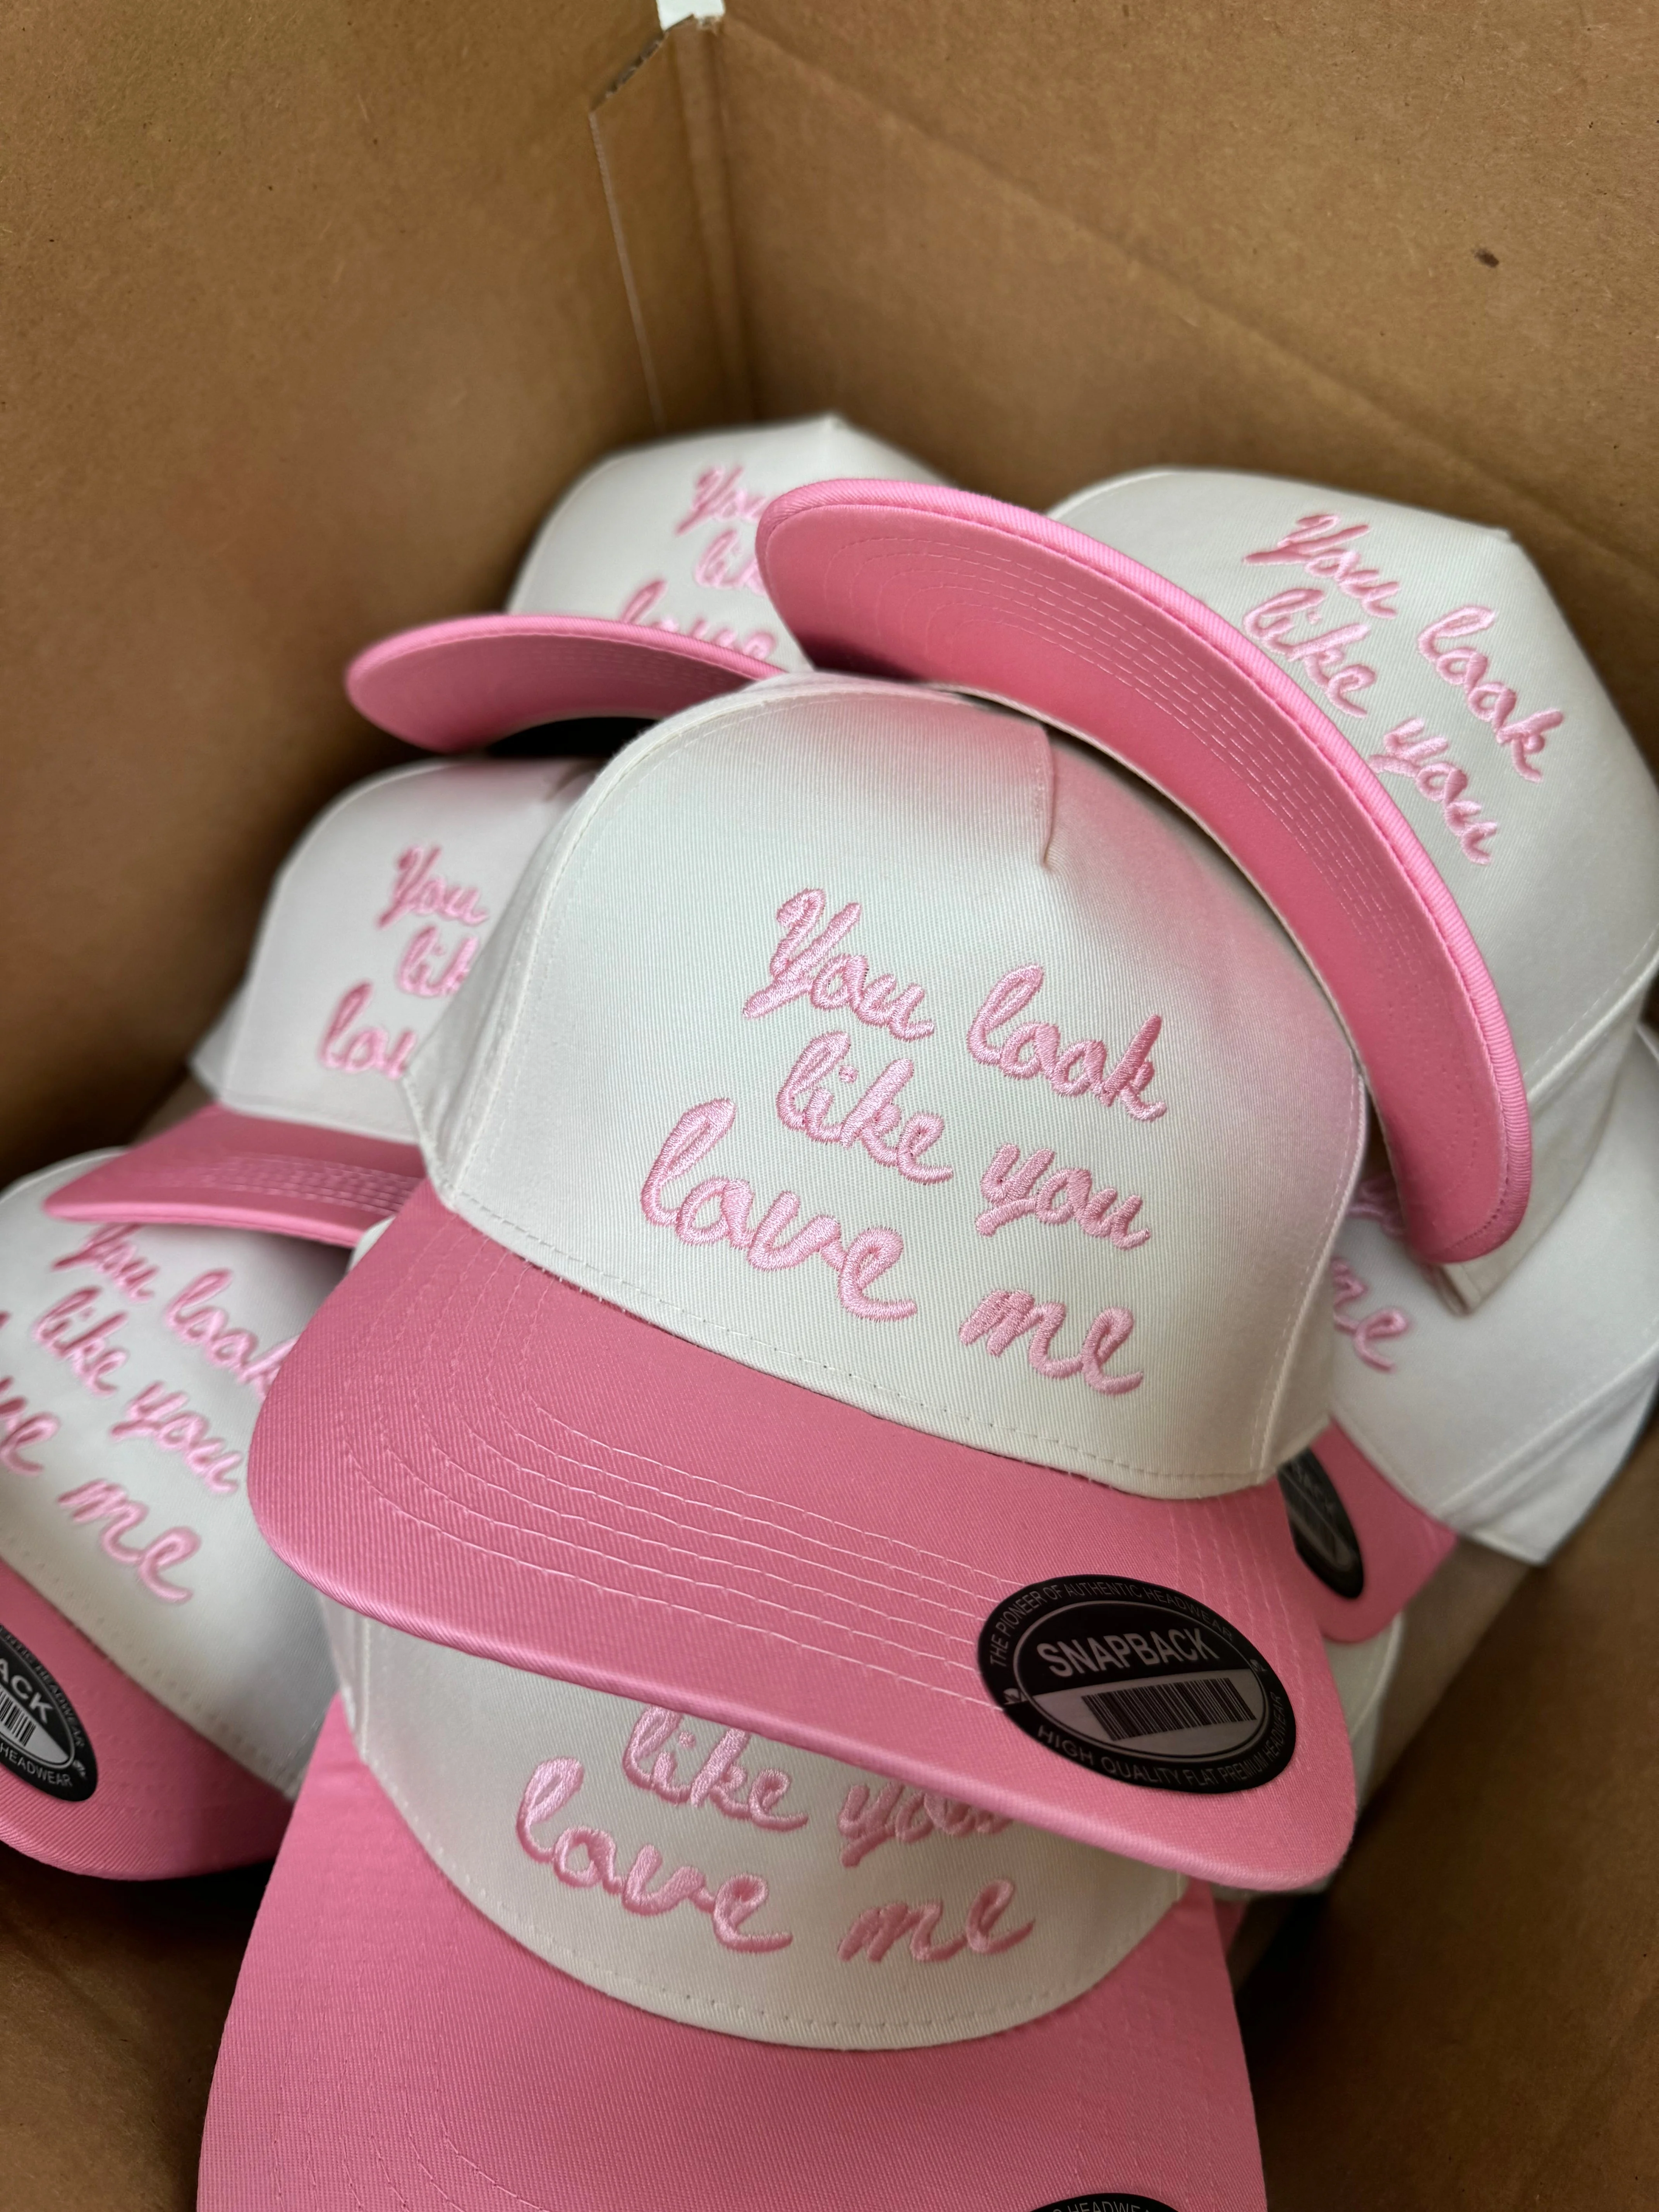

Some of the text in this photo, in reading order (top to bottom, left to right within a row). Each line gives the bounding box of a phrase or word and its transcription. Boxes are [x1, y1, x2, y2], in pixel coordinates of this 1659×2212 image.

[1243, 514, 1564, 783] You look
[1243, 587, 1498, 866] like you
[376, 847, 489, 927] You
[396, 926, 479, 998] lik
[742, 888, 1167, 1122] You look
[776, 1030, 1150, 1250] like you
[641, 1098, 1144, 1395] love me
[32, 1285, 243, 1495] like you
[57, 1477, 201, 1604] me
[990, 1581, 1233, 1666] THE PIONEER OF AUTHENTIC HEADWEAR
[1036, 1628, 1220, 1678] SNAPBACK
[622, 1705, 809, 1832] like
[1037, 1691, 1287, 1786] HIGH QUALITY FLAT PREMIUM HEADWEAR
[515, 1756, 1036, 1962] love me
